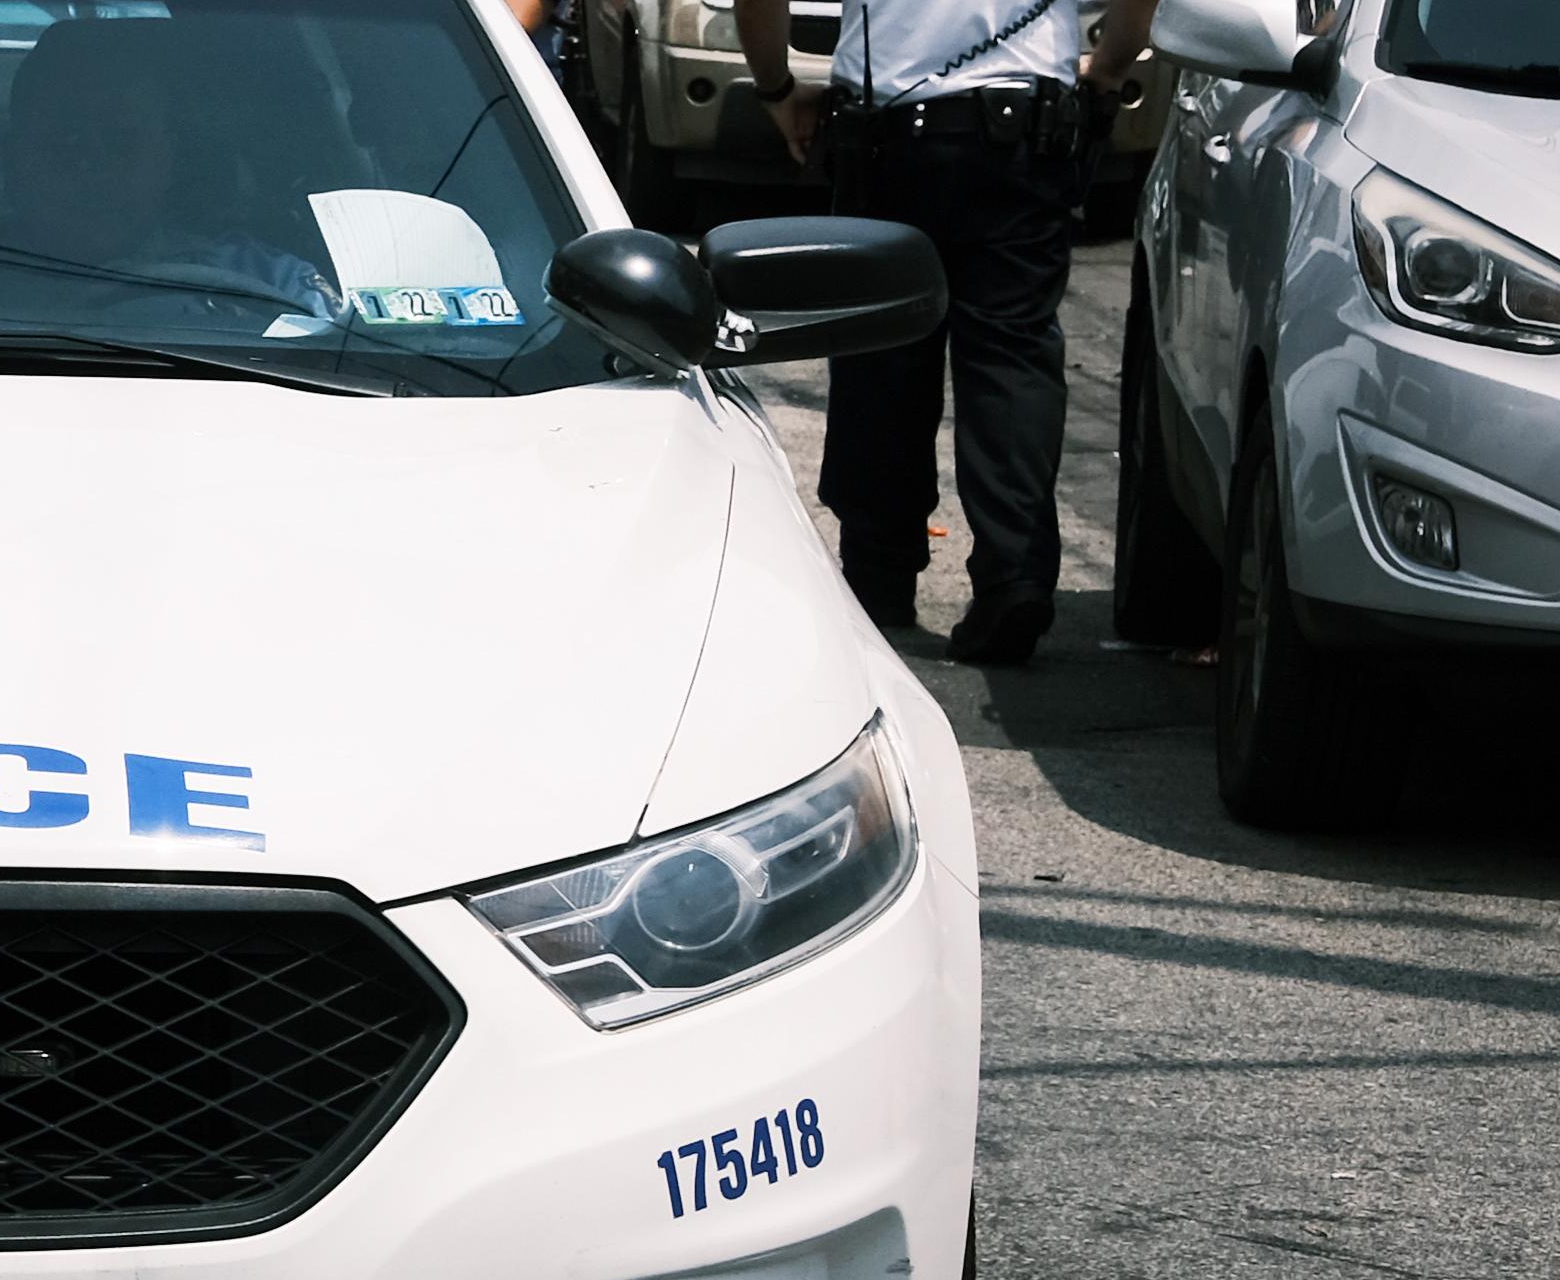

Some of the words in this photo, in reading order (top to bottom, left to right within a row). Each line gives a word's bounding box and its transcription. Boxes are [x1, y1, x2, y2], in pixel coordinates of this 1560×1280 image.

[402, 292, 434, 316] 22
[481, 292, 514, 317] 22
[657, 1098, 825, 1219] 175418
